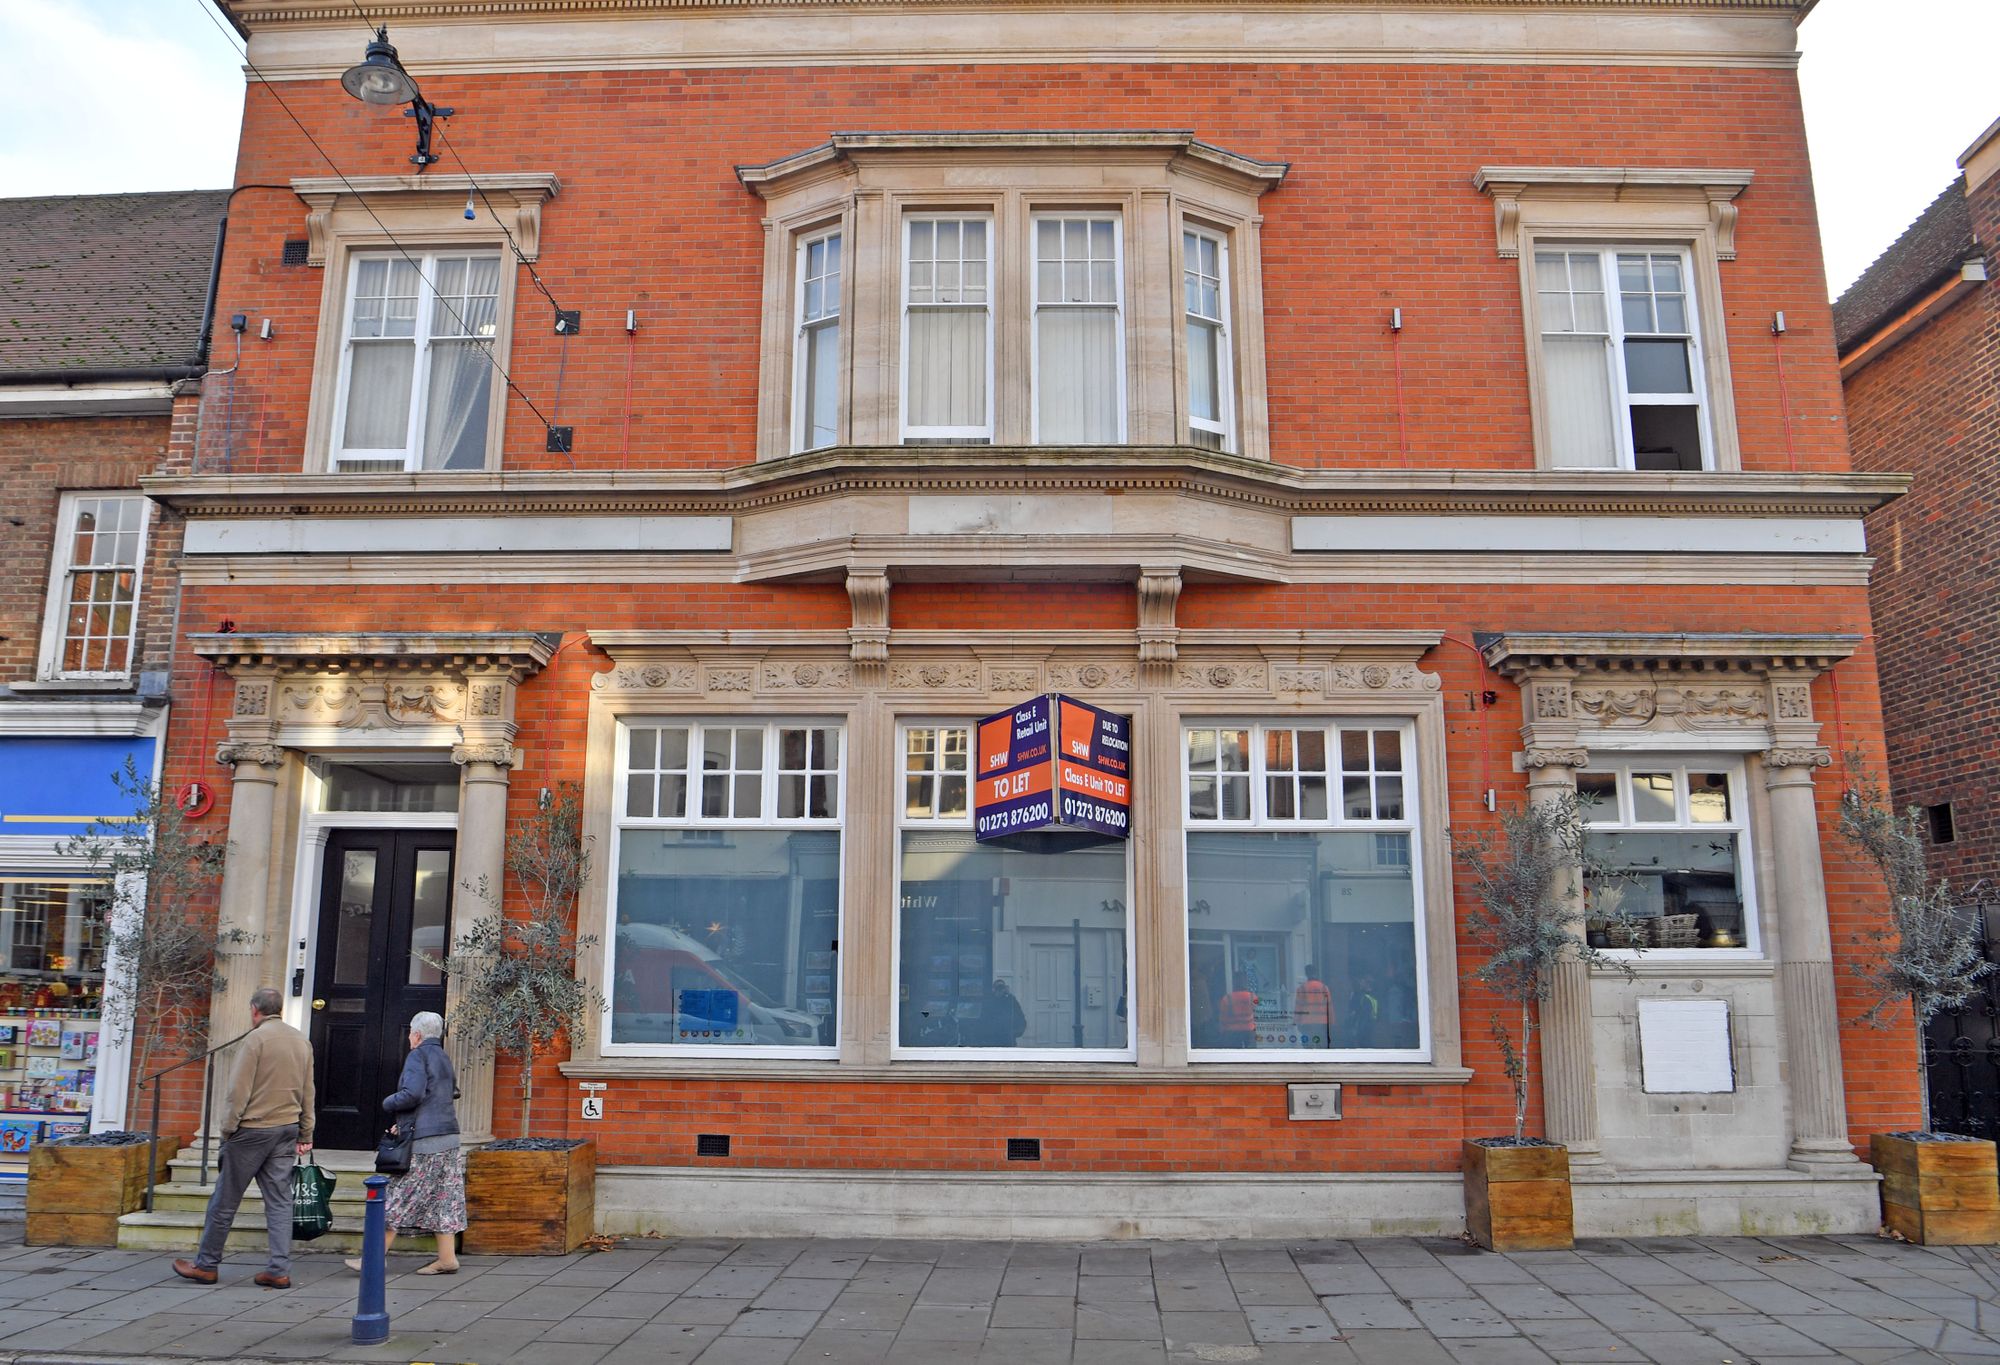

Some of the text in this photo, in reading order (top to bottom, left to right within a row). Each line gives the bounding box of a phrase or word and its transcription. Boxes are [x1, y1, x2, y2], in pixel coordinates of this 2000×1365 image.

[1016, 706, 1037, 724] Class E
[1016, 718, 1047, 740] Retail Unit
[1102, 720, 1119, 734] DUE TO
[1071, 740, 1089, 757] SHW
[1101, 734, 1129, 752] RELOCATION
[990, 751, 1009, 768] SHW
[1017, 744, 1047, 762] SHW.CO.UK
[1097, 754, 1126, 771] SHW.CO.UK
[993, 771, 1031, 799] TO LET
[1064, 767, 1126, 797] Class E Unit TO LET
[979, 802, 1048, 833] 01273 876200
[1064, 797, 1127, 828] 01273 876200
